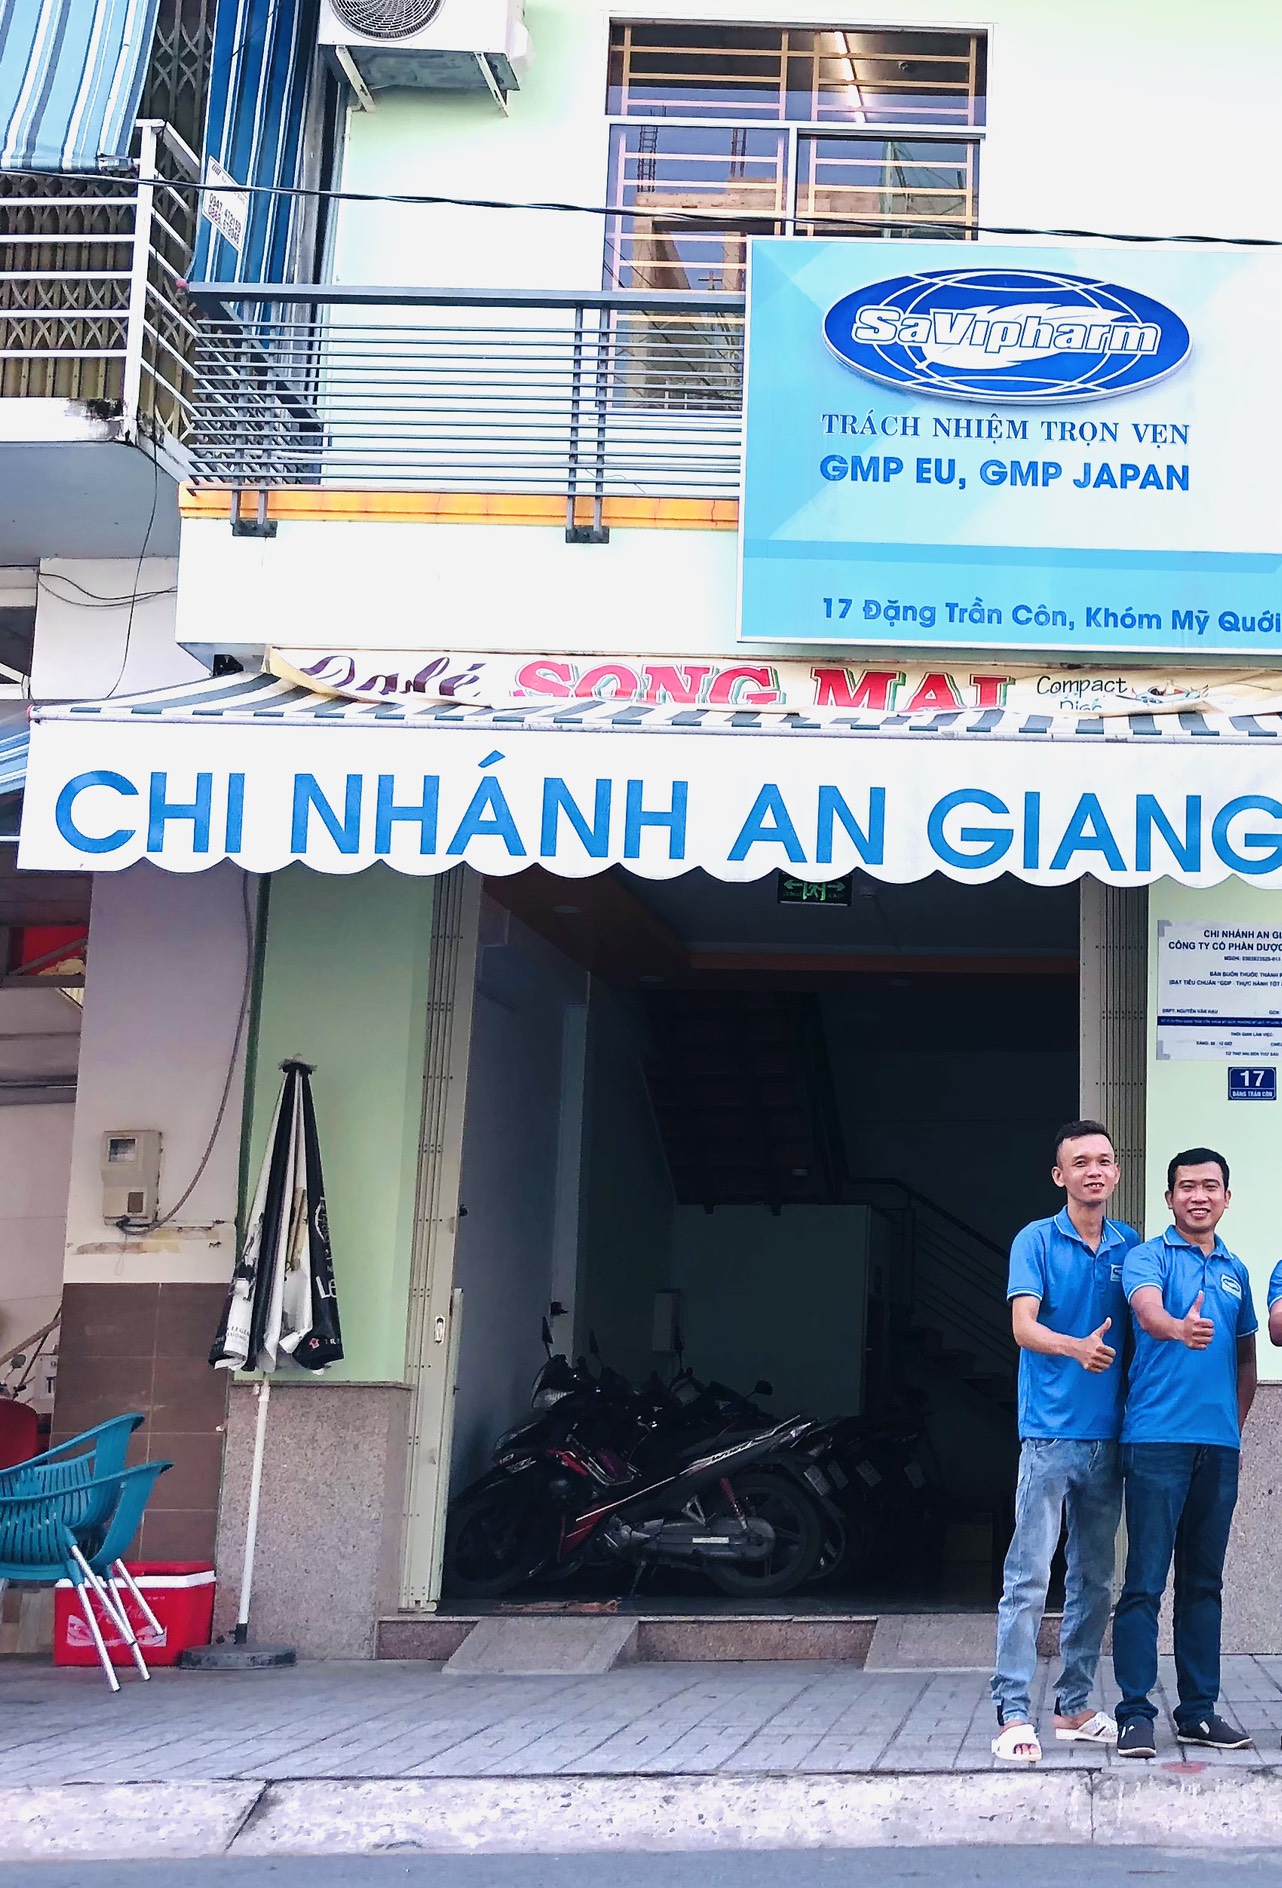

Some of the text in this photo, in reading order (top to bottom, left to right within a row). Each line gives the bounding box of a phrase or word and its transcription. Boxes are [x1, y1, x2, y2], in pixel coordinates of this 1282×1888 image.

[821, 410, 1190, 448] TRÁCH NHIỆM TRỌN VẸN
[820, 455, 1190, 491] GMP EU, GMP JAPAN
[823, 597, 852, 620] 17
[863, 599, 937, 628] Đặng
[946, 596, 1002, 625] Trần
[1012, 604, 1075, 631] Côn,
[1086, 605, 1163, 630] Khóm
[1171, 608, 1209, 635] Mỹ
[509, 660, 787, 704] SONG
[810, 667, 1015, 711] MAI
[1036, 675, 1128, 698] Compact
[55, 770, 245, 853] CHI
[289, 749, 689, 860] NHÁNH
[727, 783, 886, 865] AN
[1168, 939, 1196, 950] CÔNG
[1198, 942, 1210, 950] TY
[1203, 929, 1220, 938] CHI
[1221, 928, 1255, 939] NHÁNH
[1256, 931, 1270, 939] AN
[1240, 1070, 1265, 1087] 17
